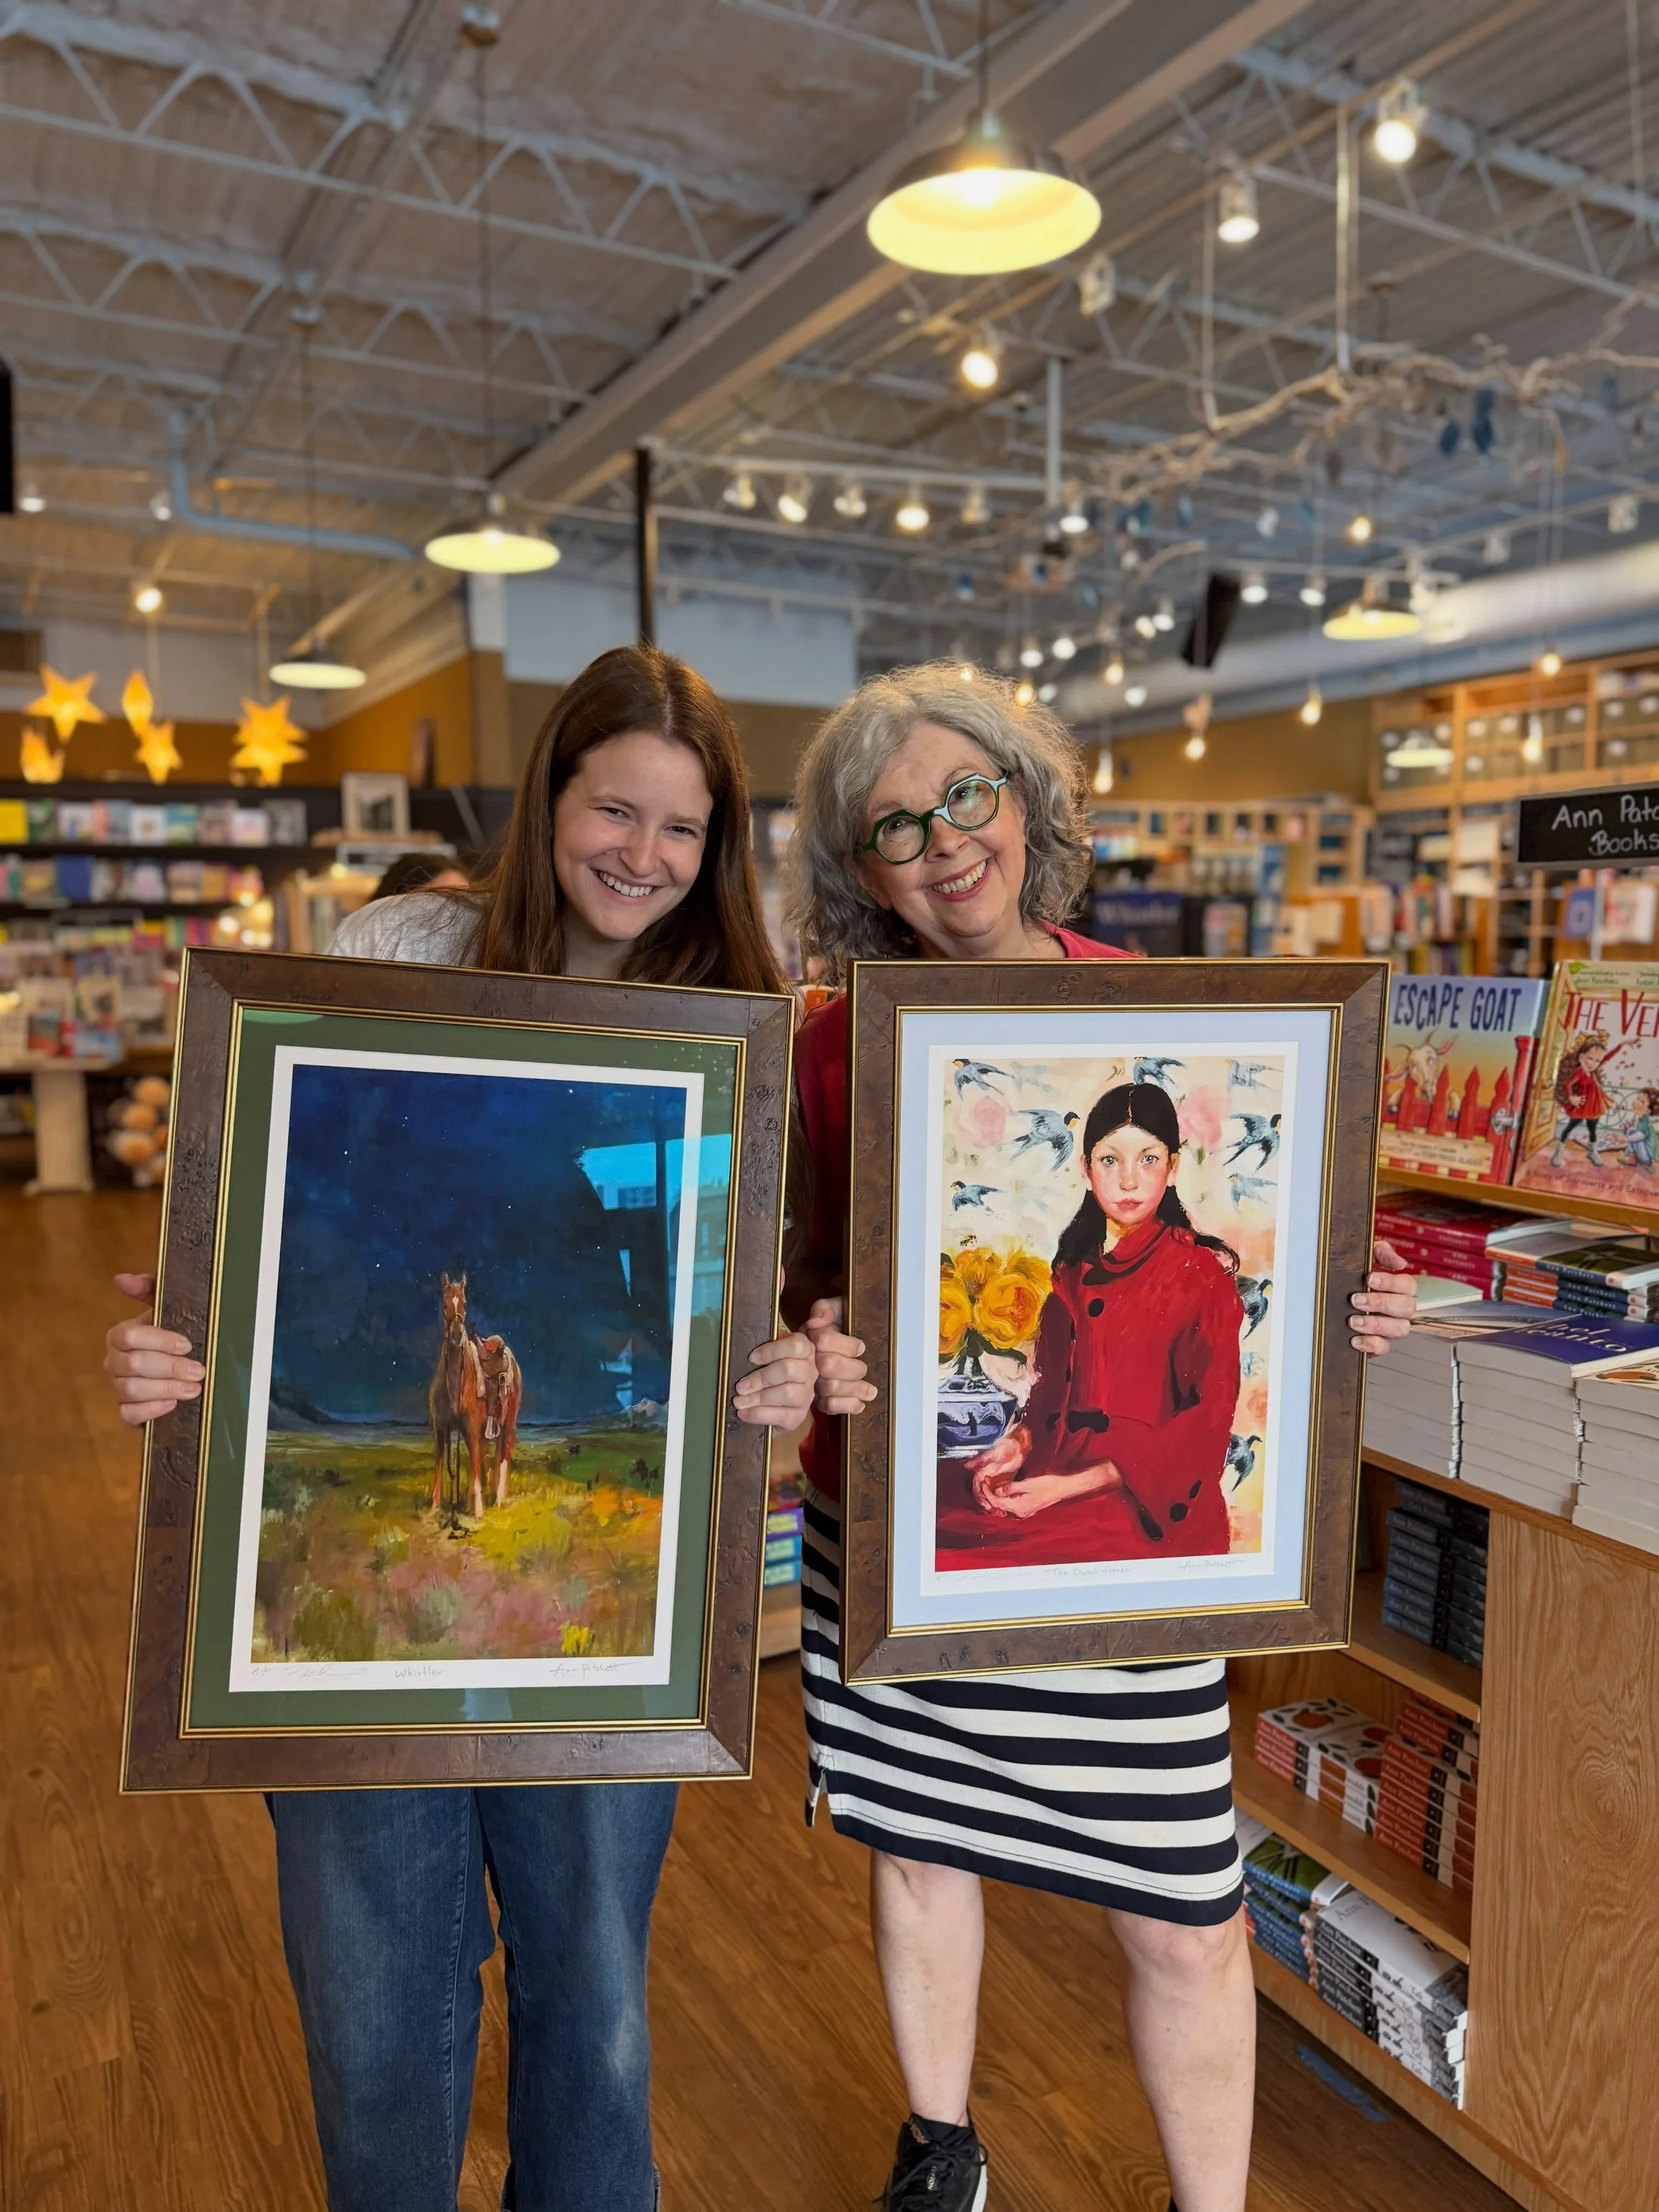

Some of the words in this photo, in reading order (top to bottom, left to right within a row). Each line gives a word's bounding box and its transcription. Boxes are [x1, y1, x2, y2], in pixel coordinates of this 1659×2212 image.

[1551, 804, 1603, 830] Ann
[1588, 828, 1659, 856] Books
[1394, 982, 1465, 1031] ESCAPE
[1470, 986, 1522, 1032] GOAT
[1565, 991, 1609, 1031] THE
[1607, 1181, 1623, 1191] and
[395, 1664, 445, 1678] Whistler
[1334, 1901, 1362, 1921] Ann
[928, 2166, 937, 2191] CLIFTON
